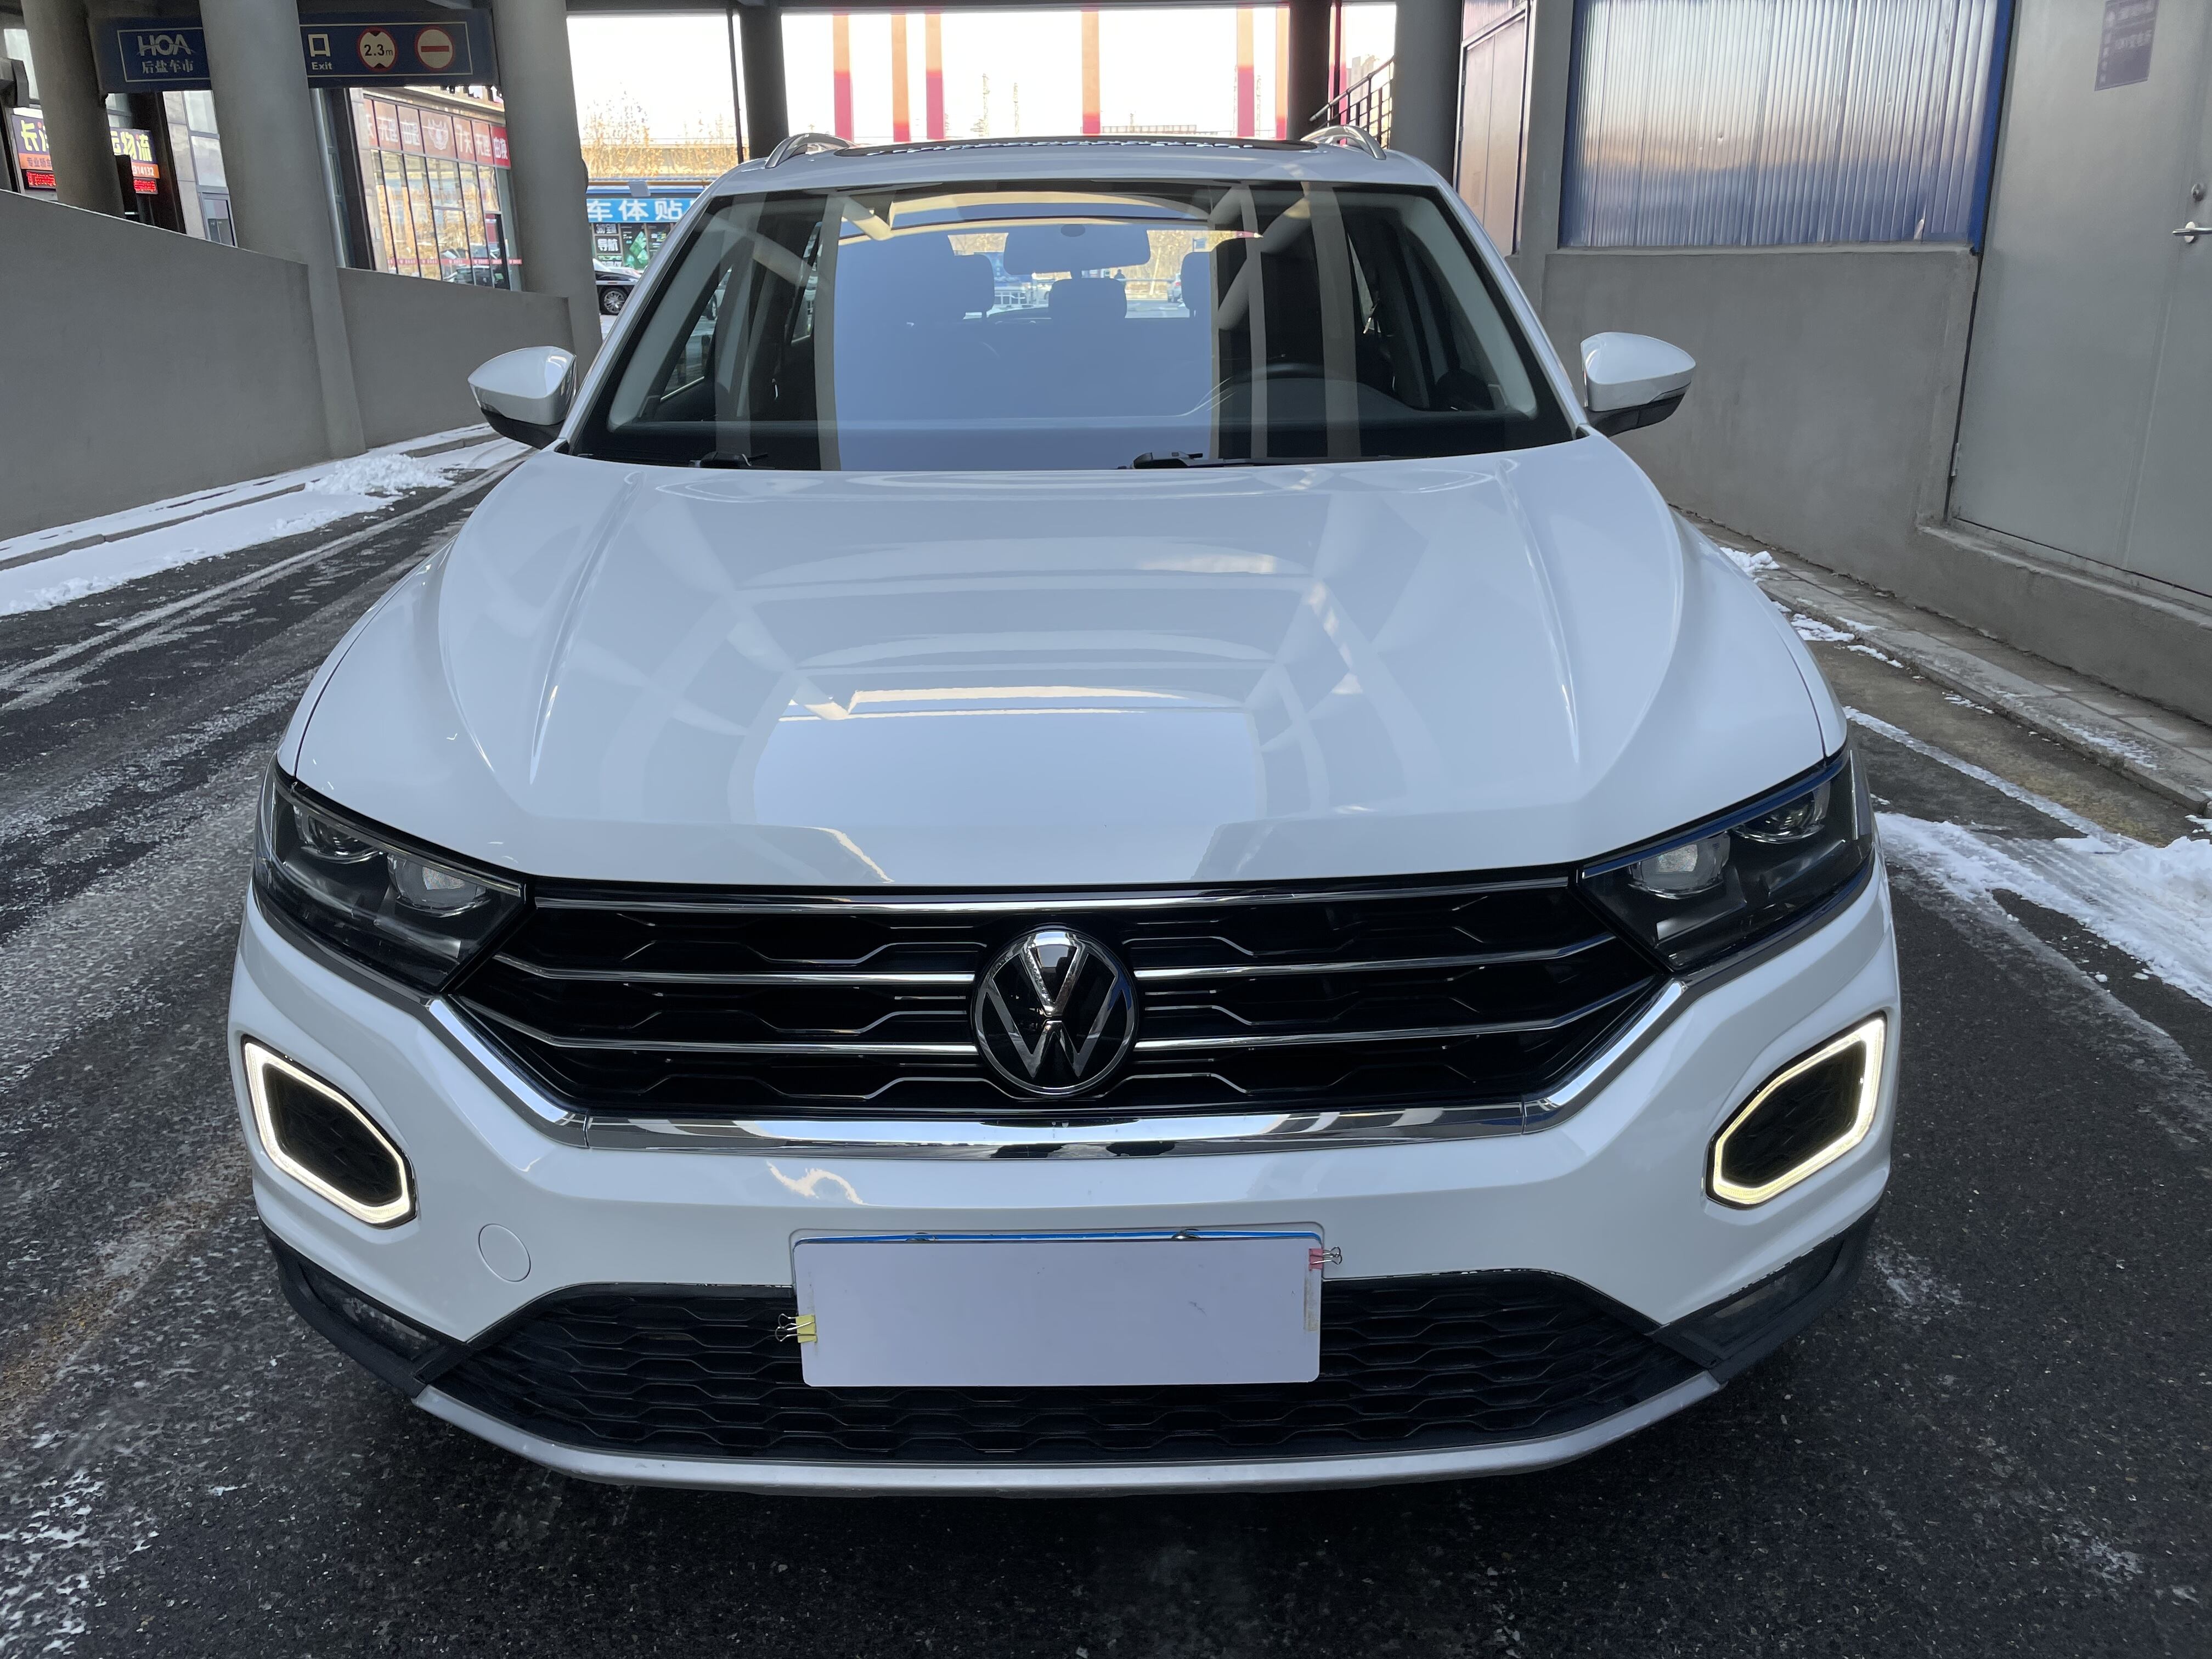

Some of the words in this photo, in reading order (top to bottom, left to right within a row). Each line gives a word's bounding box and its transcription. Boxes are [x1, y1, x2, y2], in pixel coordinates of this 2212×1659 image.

[138, 34, 192, 56] HOA
[364, 44, 393, 56] 2.3m
[312, 61, 332, 70] Exit
[587, 199, 695, 221] 车体贴
